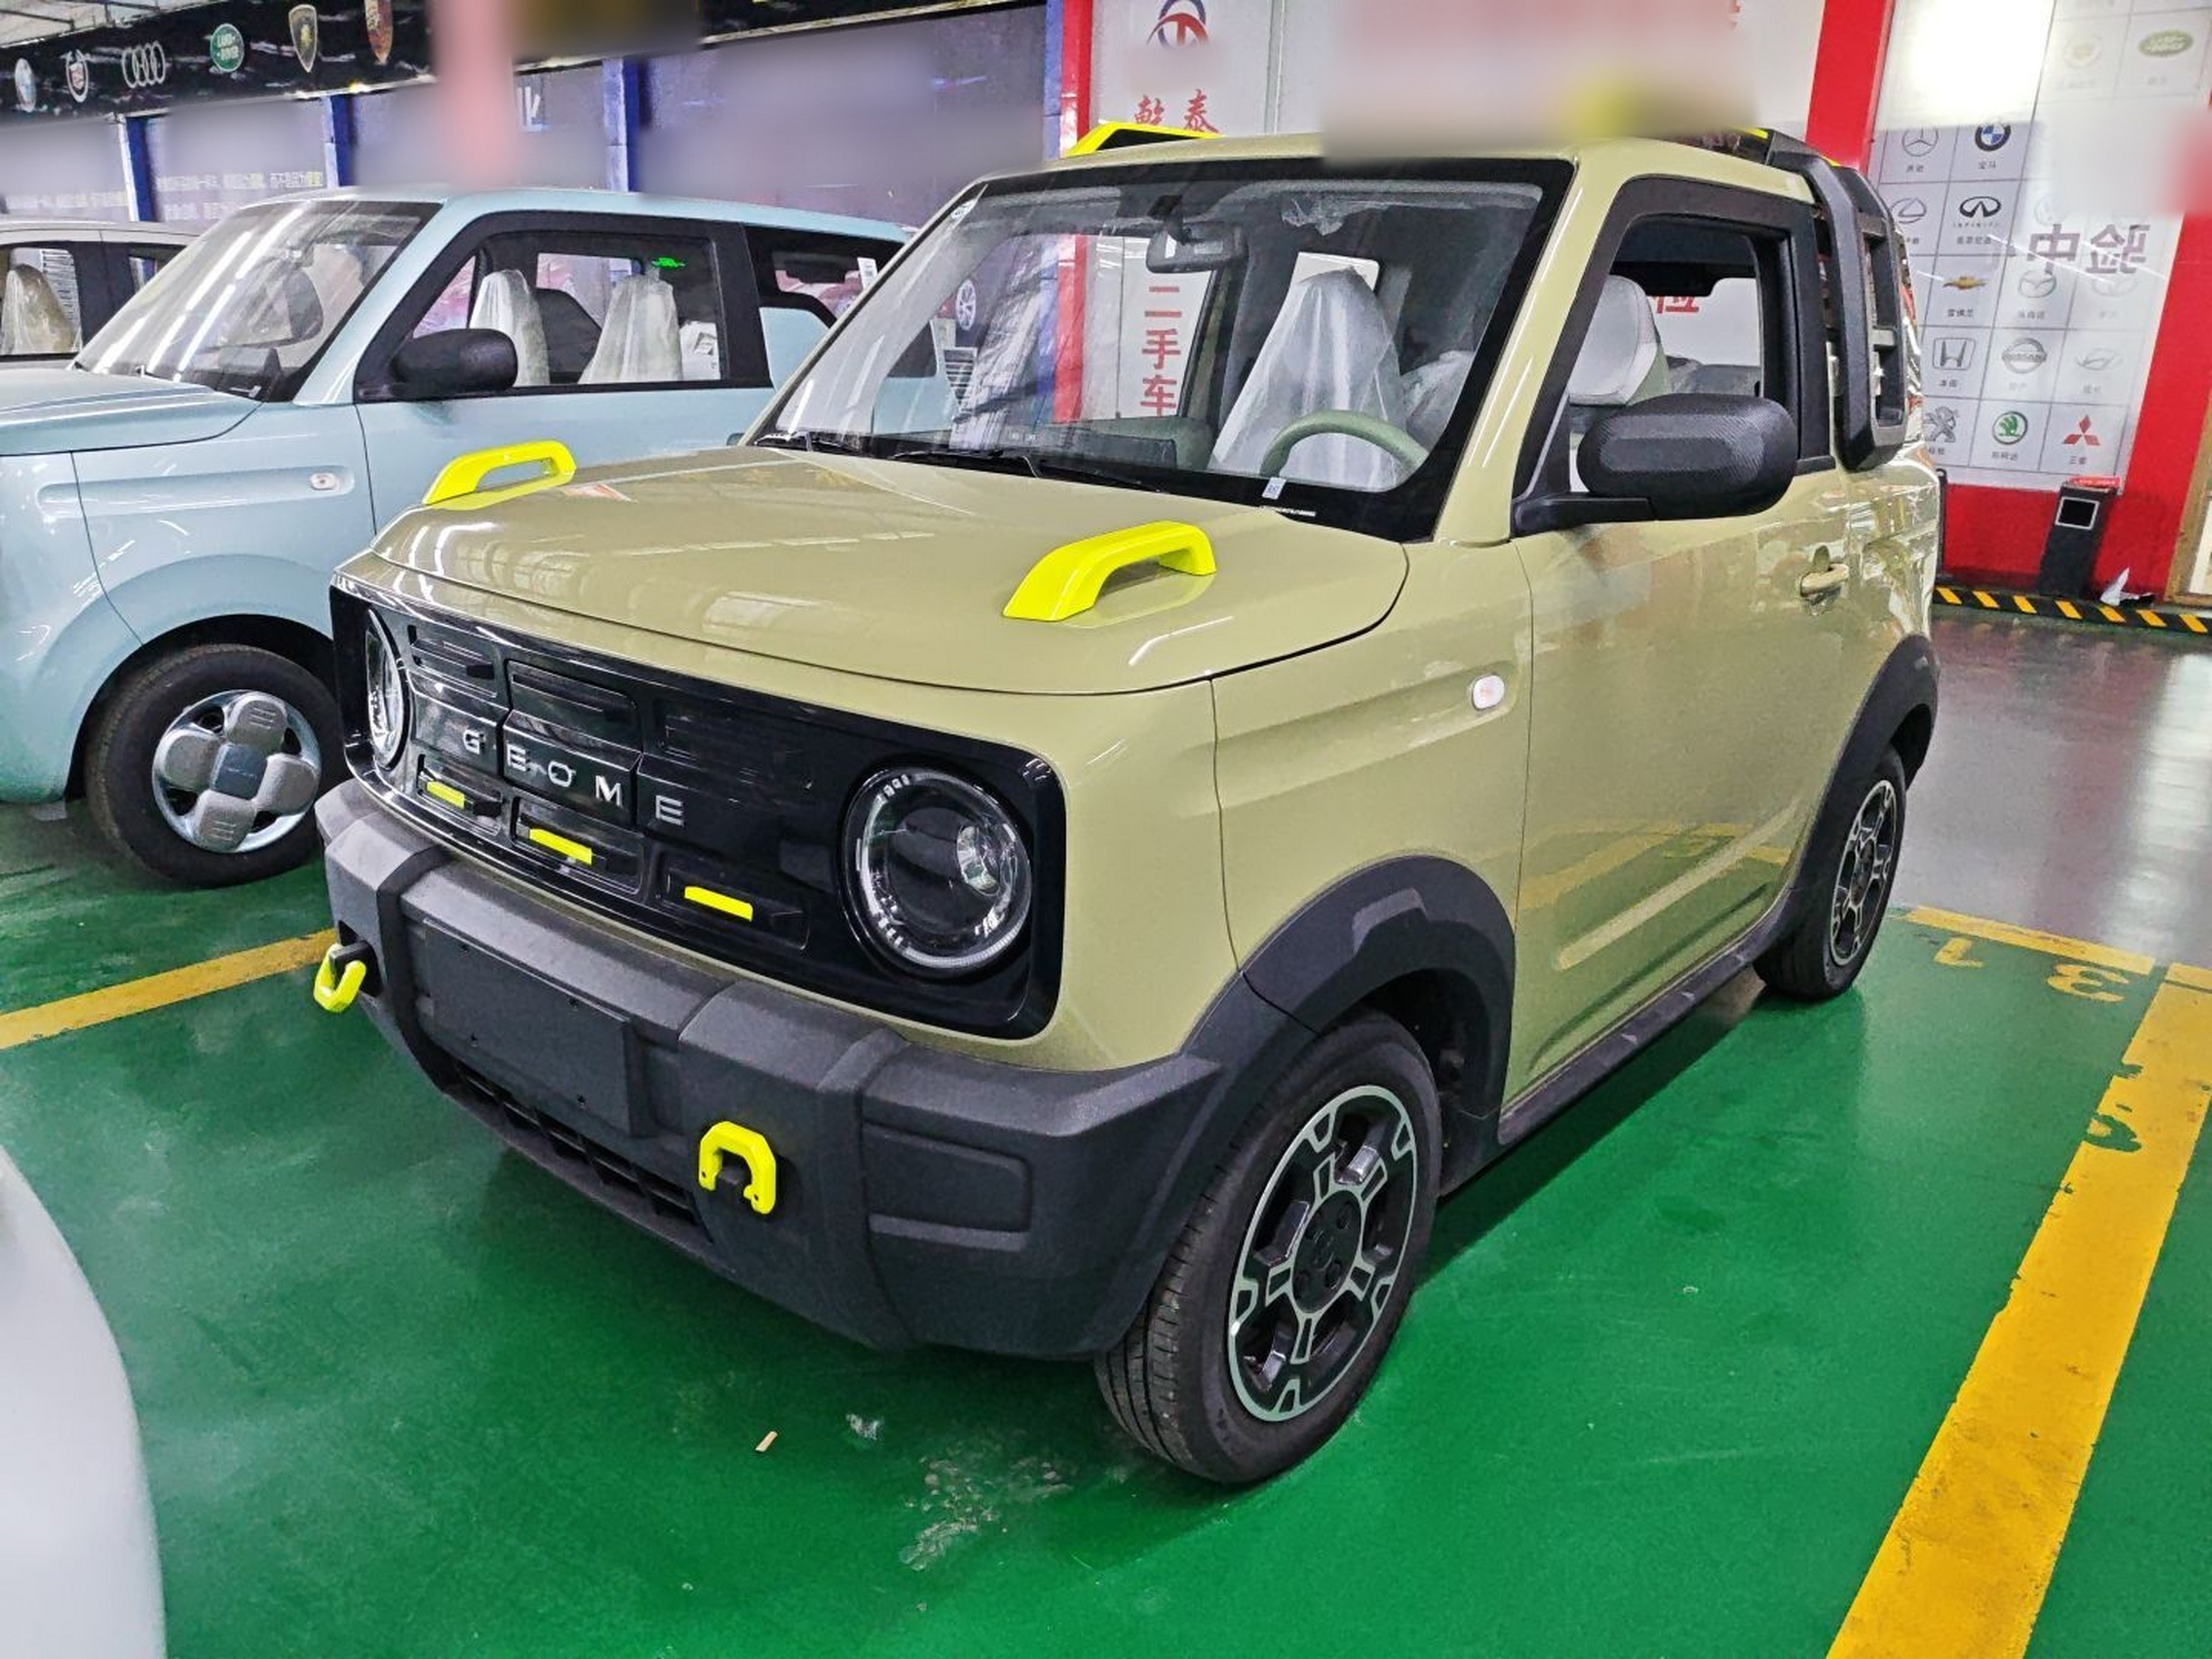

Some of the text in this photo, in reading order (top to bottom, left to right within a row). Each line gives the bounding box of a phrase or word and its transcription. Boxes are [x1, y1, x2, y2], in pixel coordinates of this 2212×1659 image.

[1140, 286, 1182, 418] 二手车
[462, 728, 684, 826] GEOME
